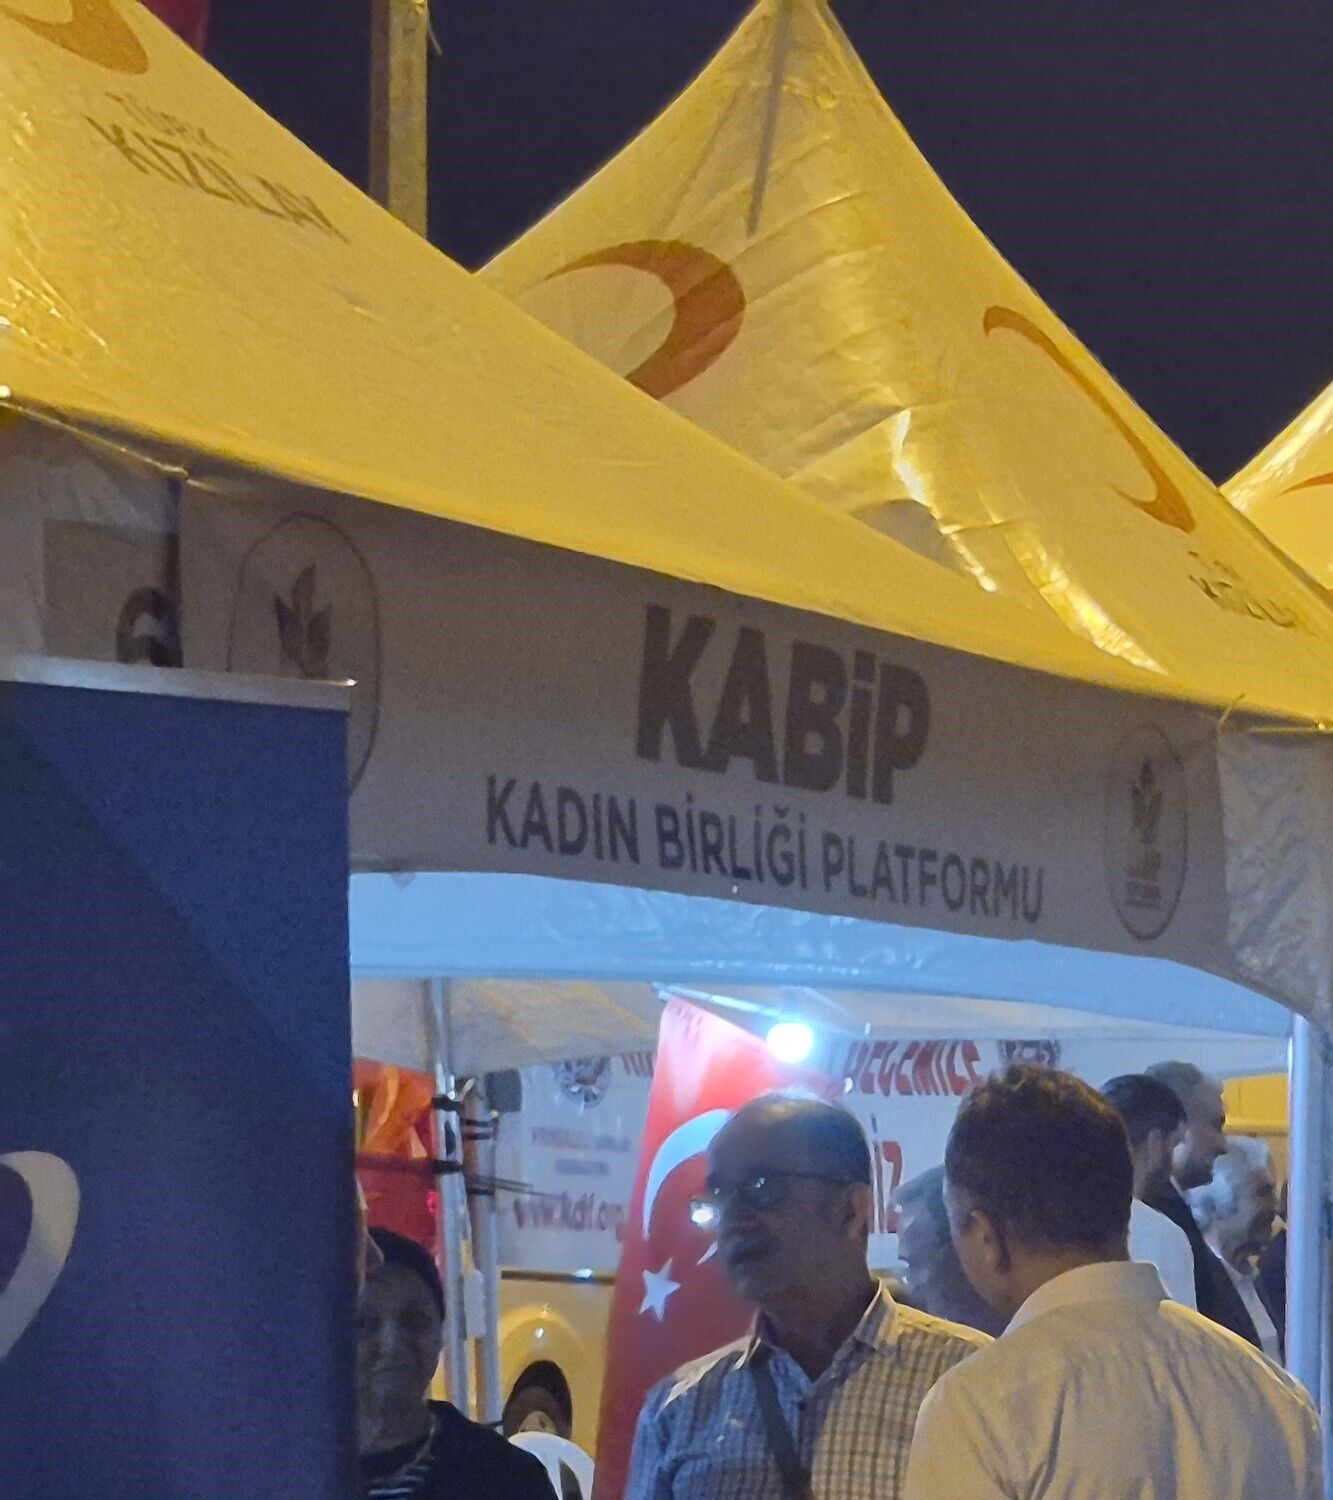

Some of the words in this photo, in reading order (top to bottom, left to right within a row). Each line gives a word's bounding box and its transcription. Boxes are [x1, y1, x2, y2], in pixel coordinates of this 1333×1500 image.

[635, 605, 932, 805] KABİP
[484, 775, 640, 867] KADIN
[656, 792, 809, 891] BİRLİĞİ
[822, 832, 1046, 925] PLATFORMU
